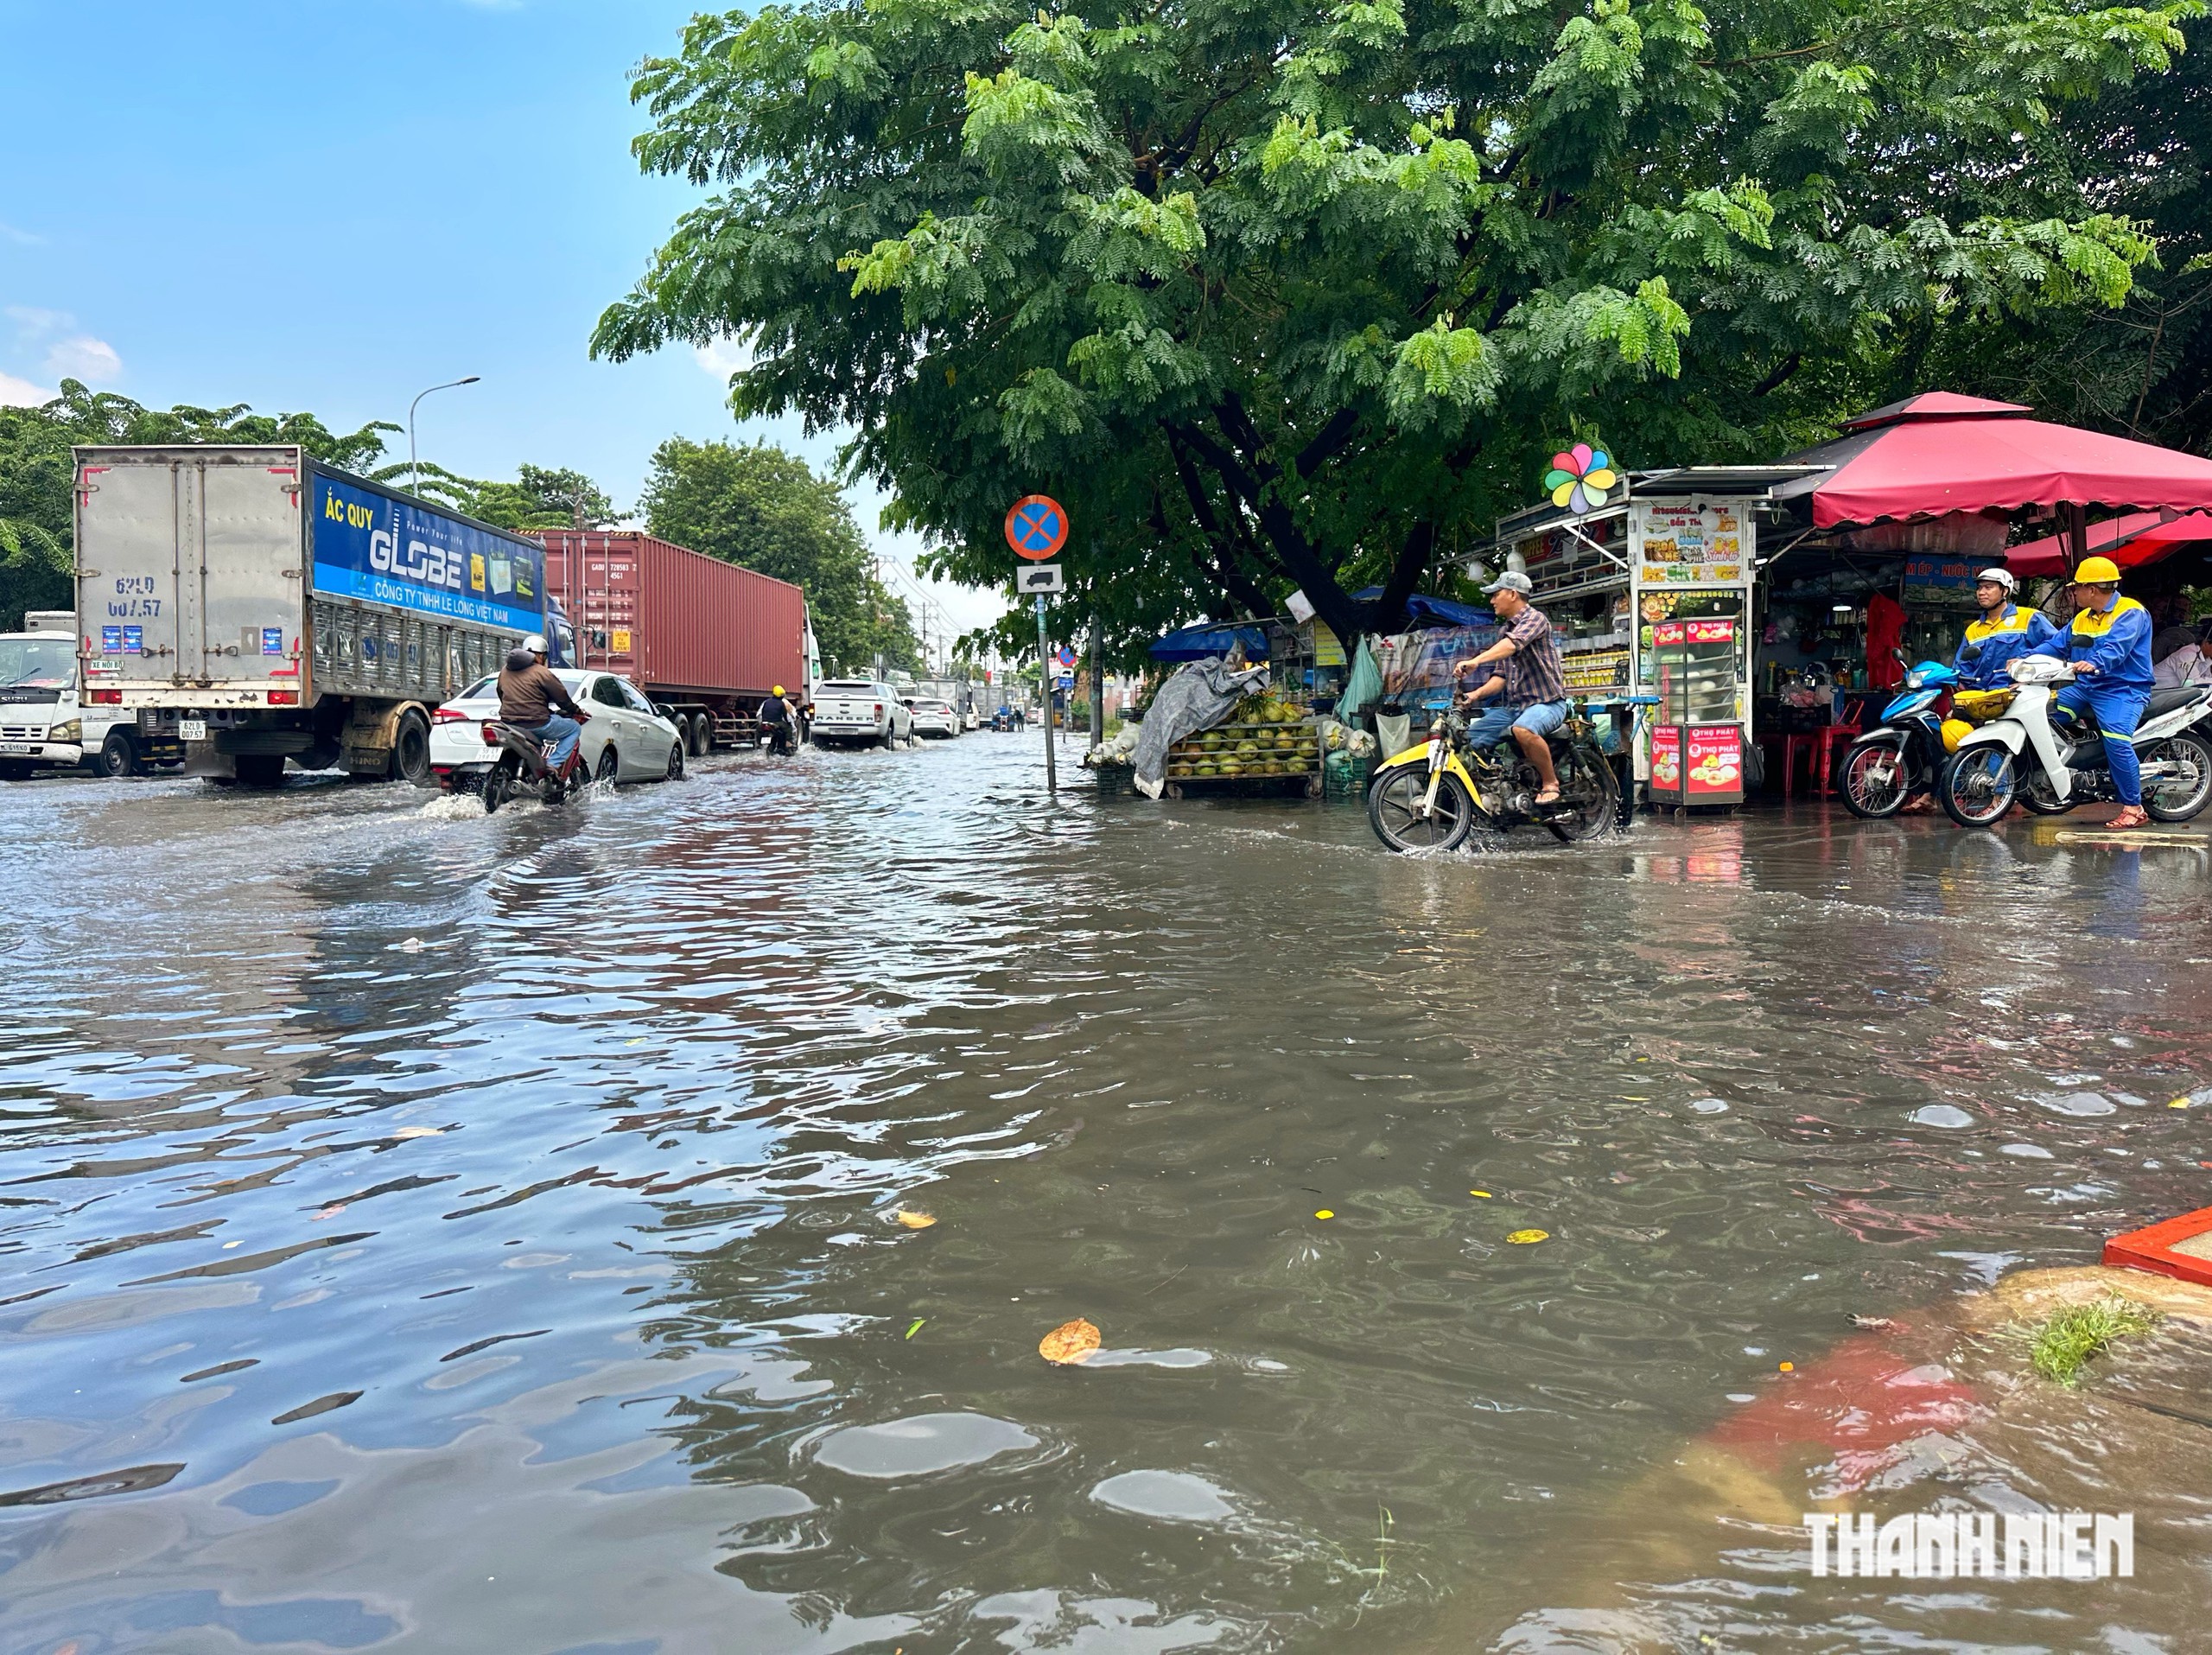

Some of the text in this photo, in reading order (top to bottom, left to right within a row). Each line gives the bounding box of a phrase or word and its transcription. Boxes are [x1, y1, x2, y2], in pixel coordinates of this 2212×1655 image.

[325, 486, 374, 531] ẮC QUY
[406, 520, 429, 535] Power
[369, 510, 463, 589] GLOBE
[1706, 548, 1726, 562] Sinh
[1918, 560, 1932, 576] ÉP
[1941, 562, 1969, 577] NƯỚC
[375, 581, 403, 602] CÔNG
[404, 589, 416, 602] TY
[418, 591, 440, 608] TNHH
[442, 596, 453, 610] LE
[453, 600, 474, 616] LONG
[476, 602, 493, 621] VIỆT
[493, 610, 509, 624] NAM
[1716, 727, 1735, 735] PHÁT
[1668, 743, 1680, 752] PHÁT
[1700, 743, 1738, 754] THỌ PHÁT
[349, 756, 381, 766] HINO
